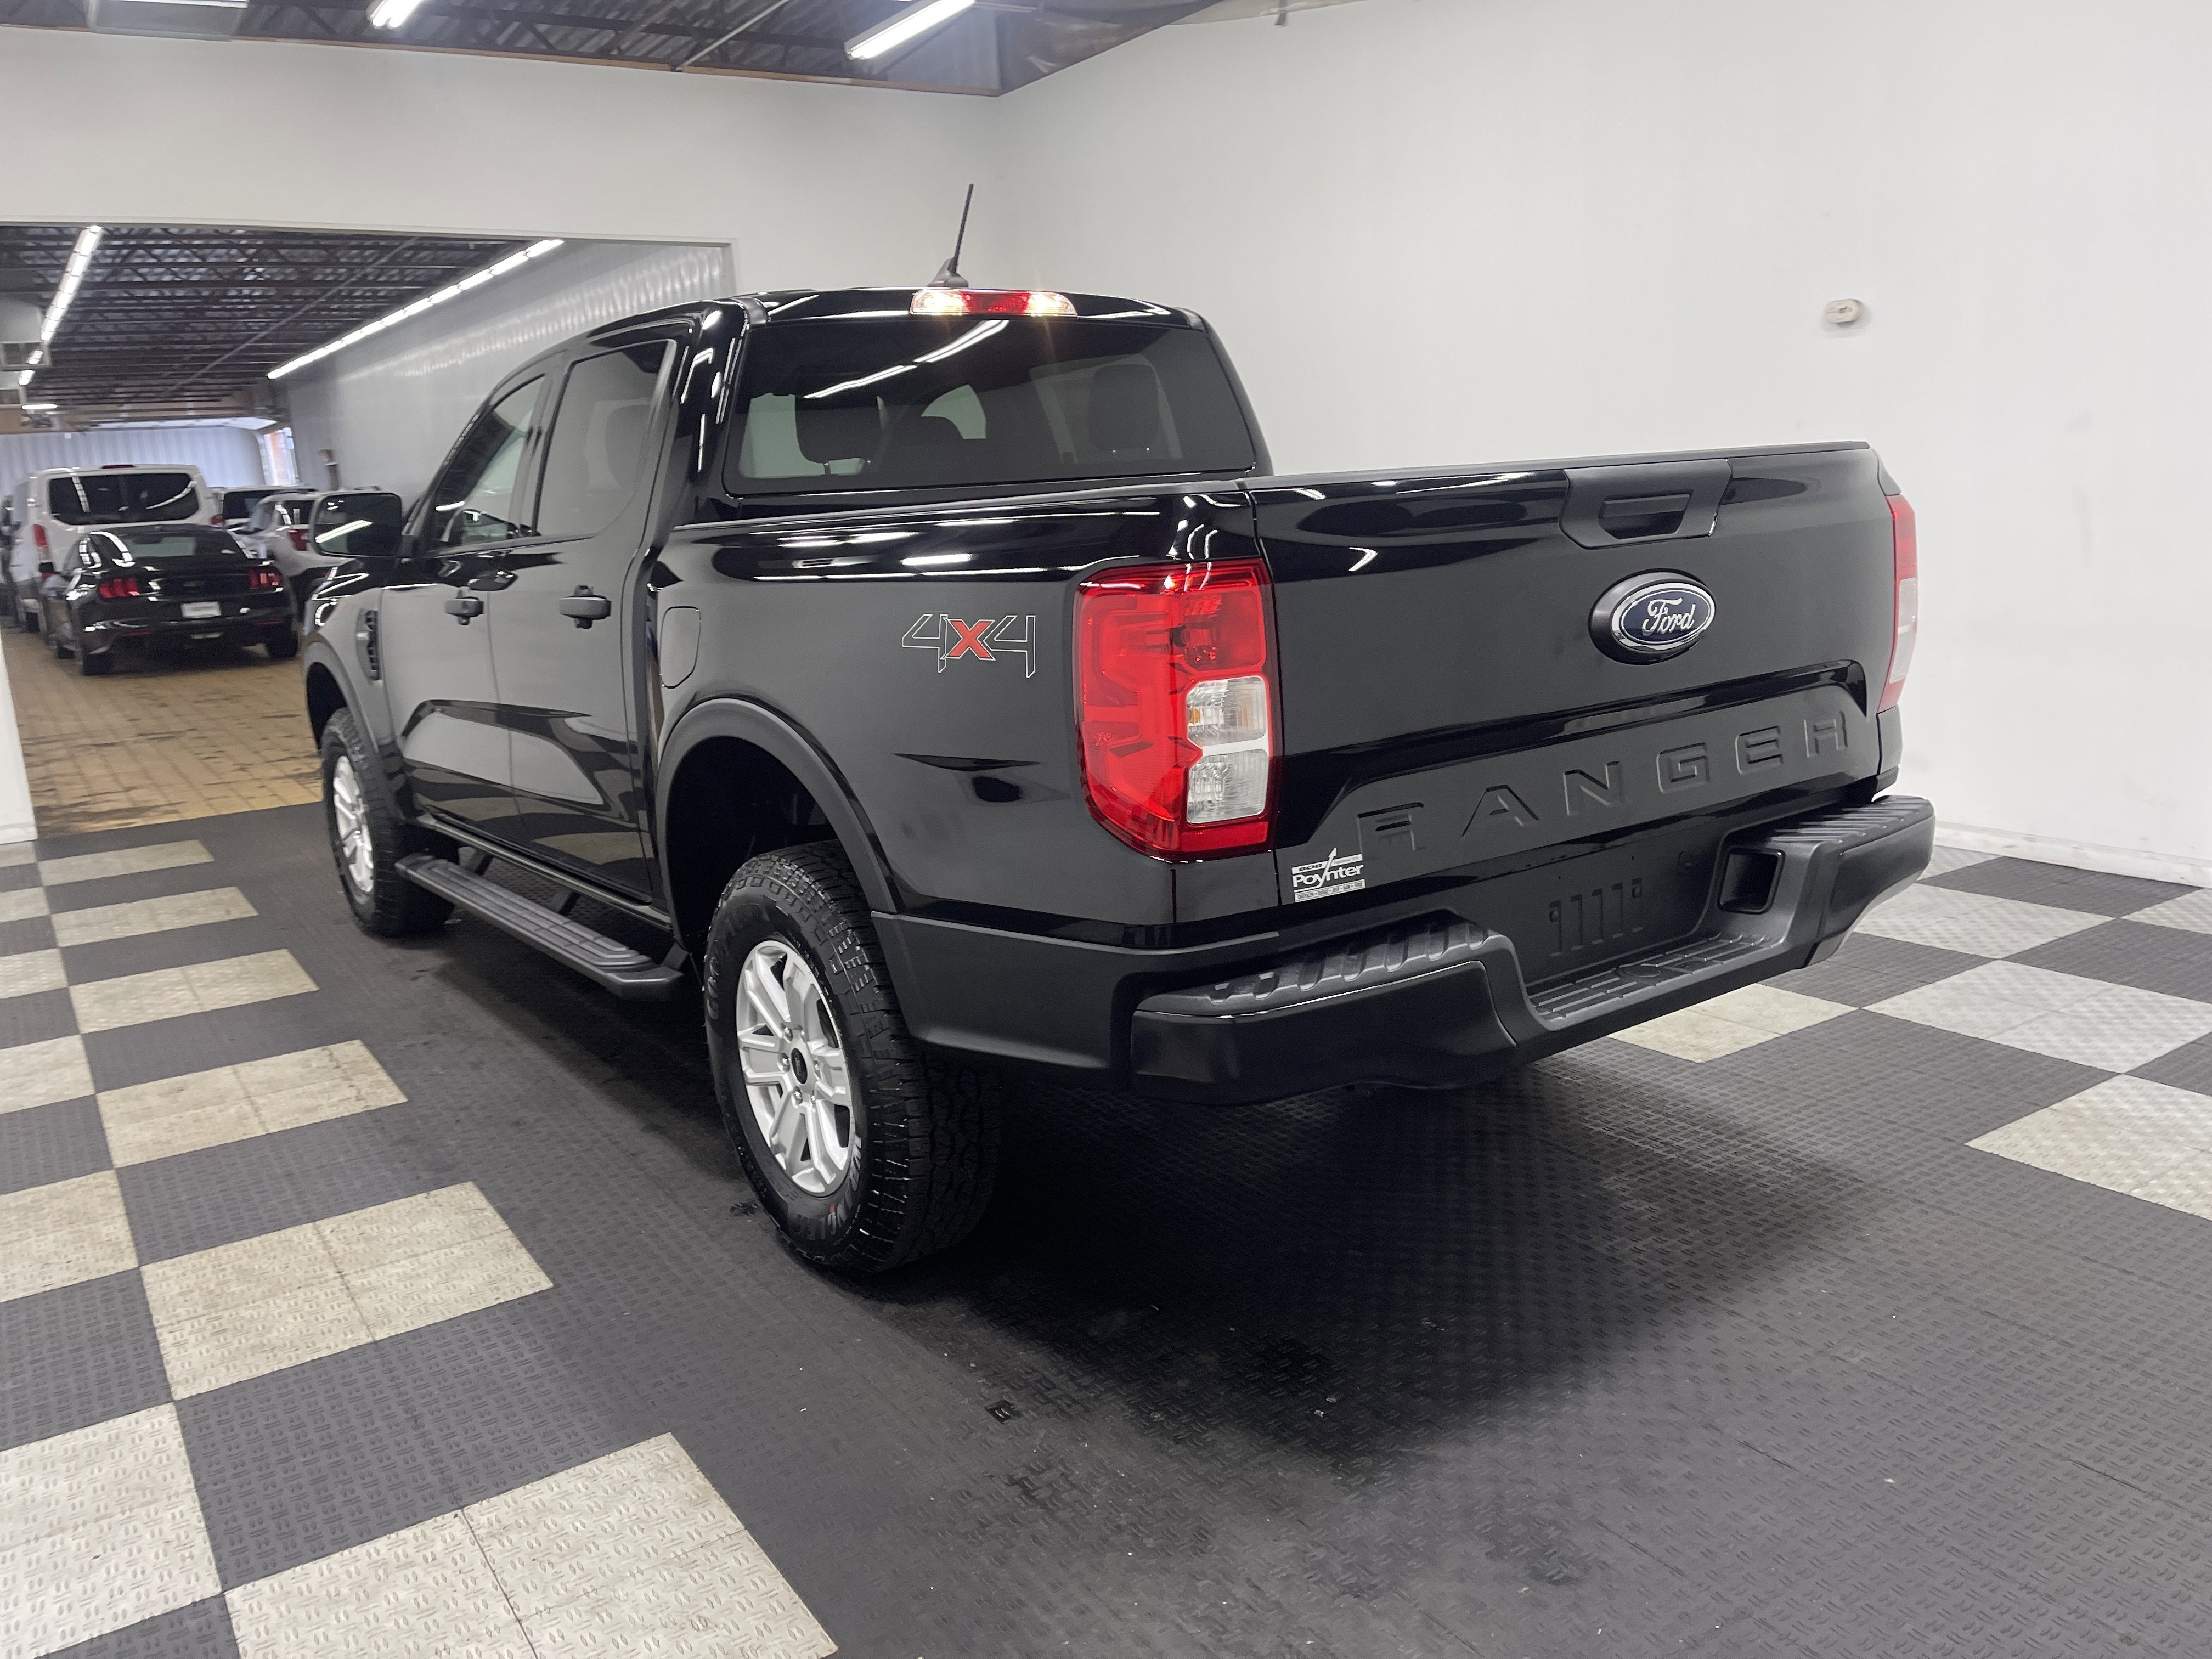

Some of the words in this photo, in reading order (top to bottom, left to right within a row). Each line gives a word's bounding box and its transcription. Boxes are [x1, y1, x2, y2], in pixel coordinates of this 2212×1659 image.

[1642, 597, 1696, 636] Ford
[1357, 710, 1848, 854] RANGER
[1293, 864, 1364, 888] Poynter
